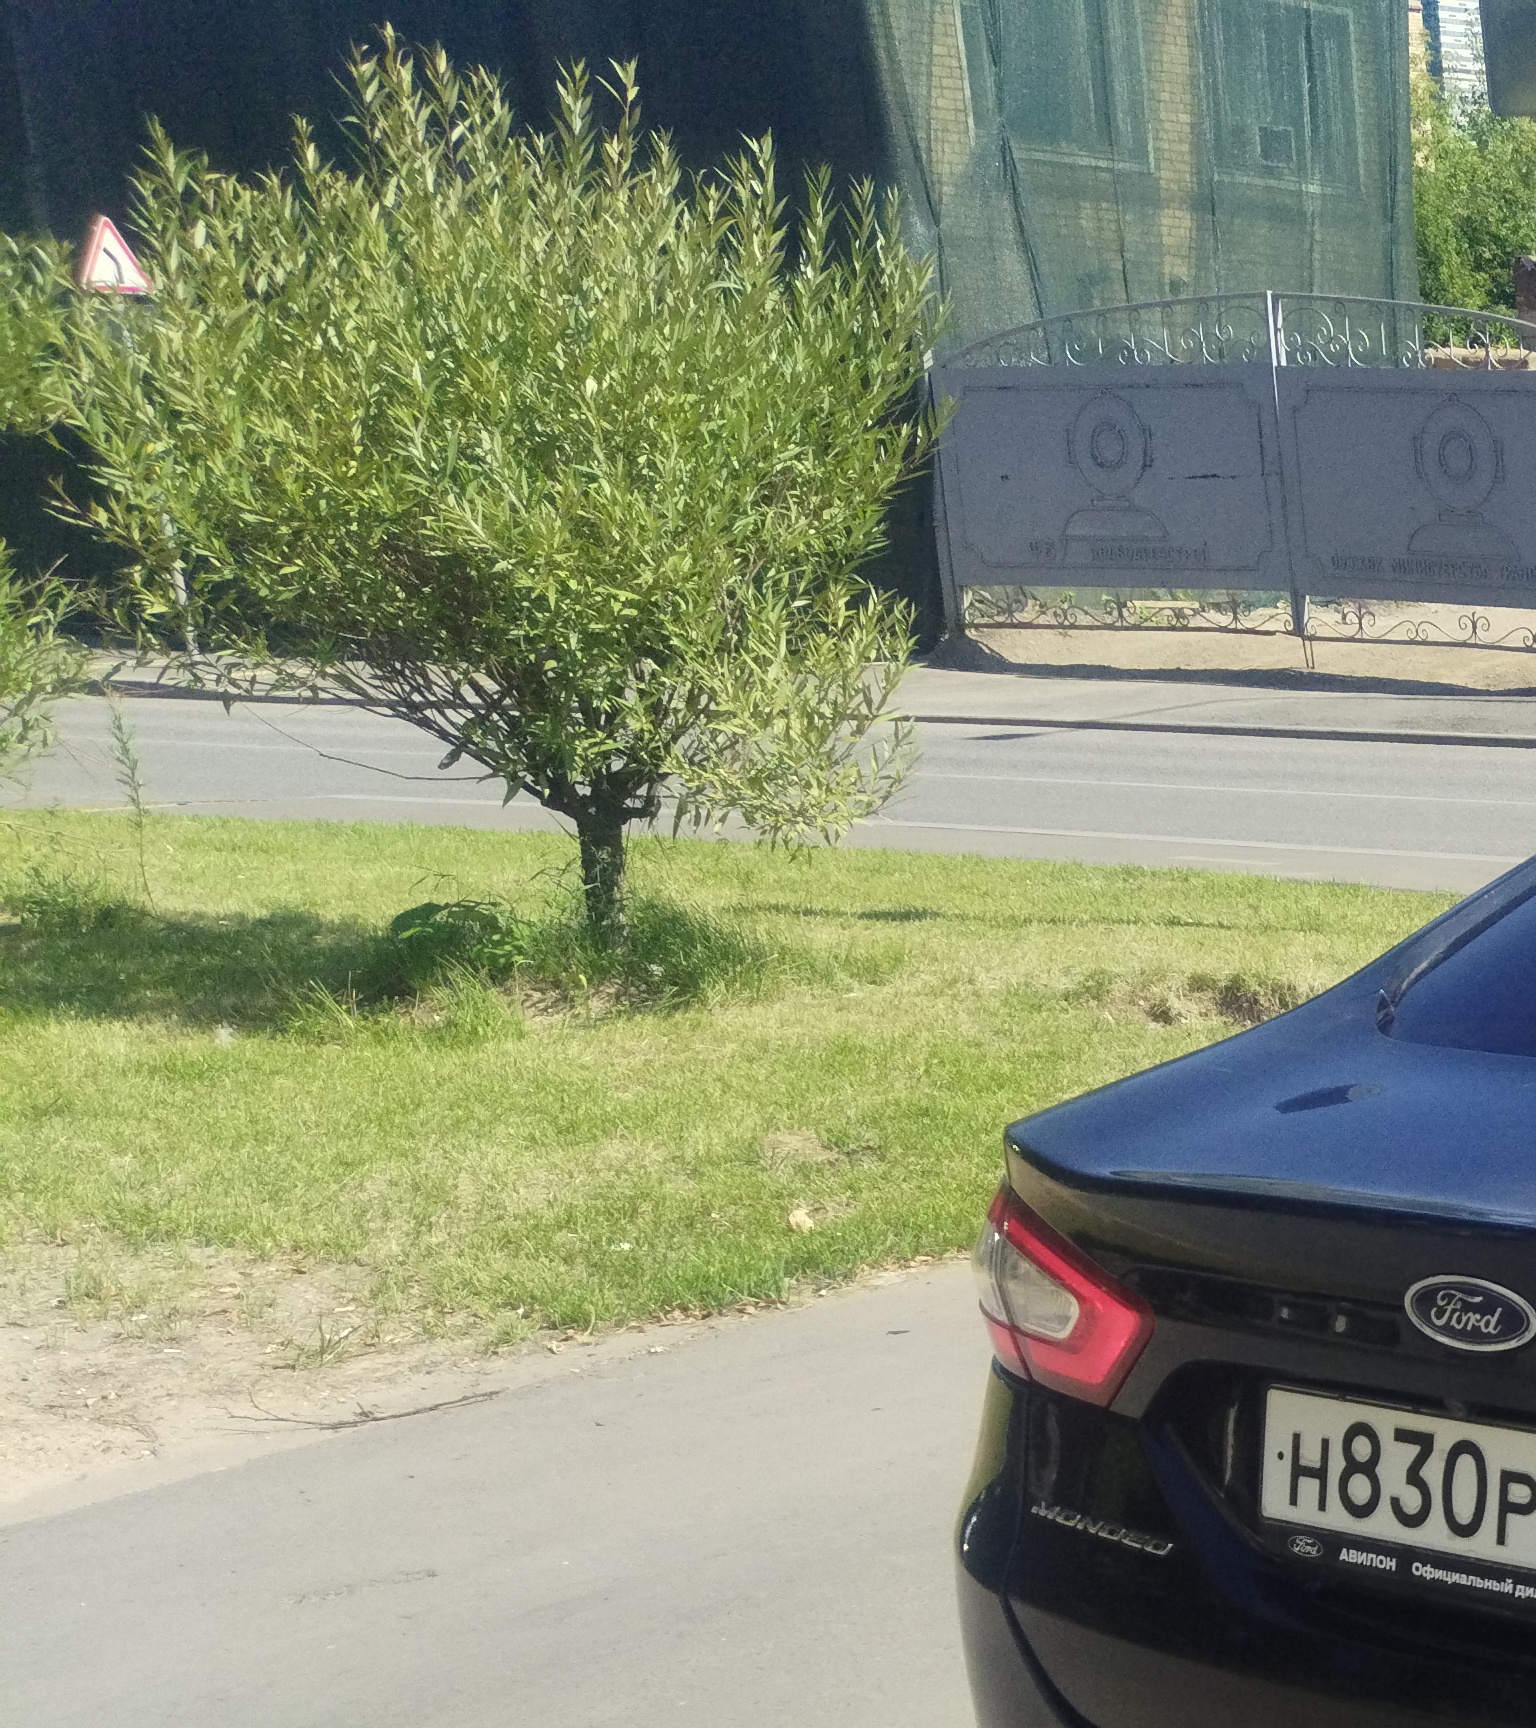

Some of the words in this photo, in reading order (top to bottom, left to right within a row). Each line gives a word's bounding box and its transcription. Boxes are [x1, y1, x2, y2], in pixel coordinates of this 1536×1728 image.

[1430, 1289, 1503, 1335] Ford
[1293, 1538, 1319, 1555] Ford
[1339, 1548, 1397, 1571] АВИЛОН
[1412, 1562, 1514, 1594] Официальный
